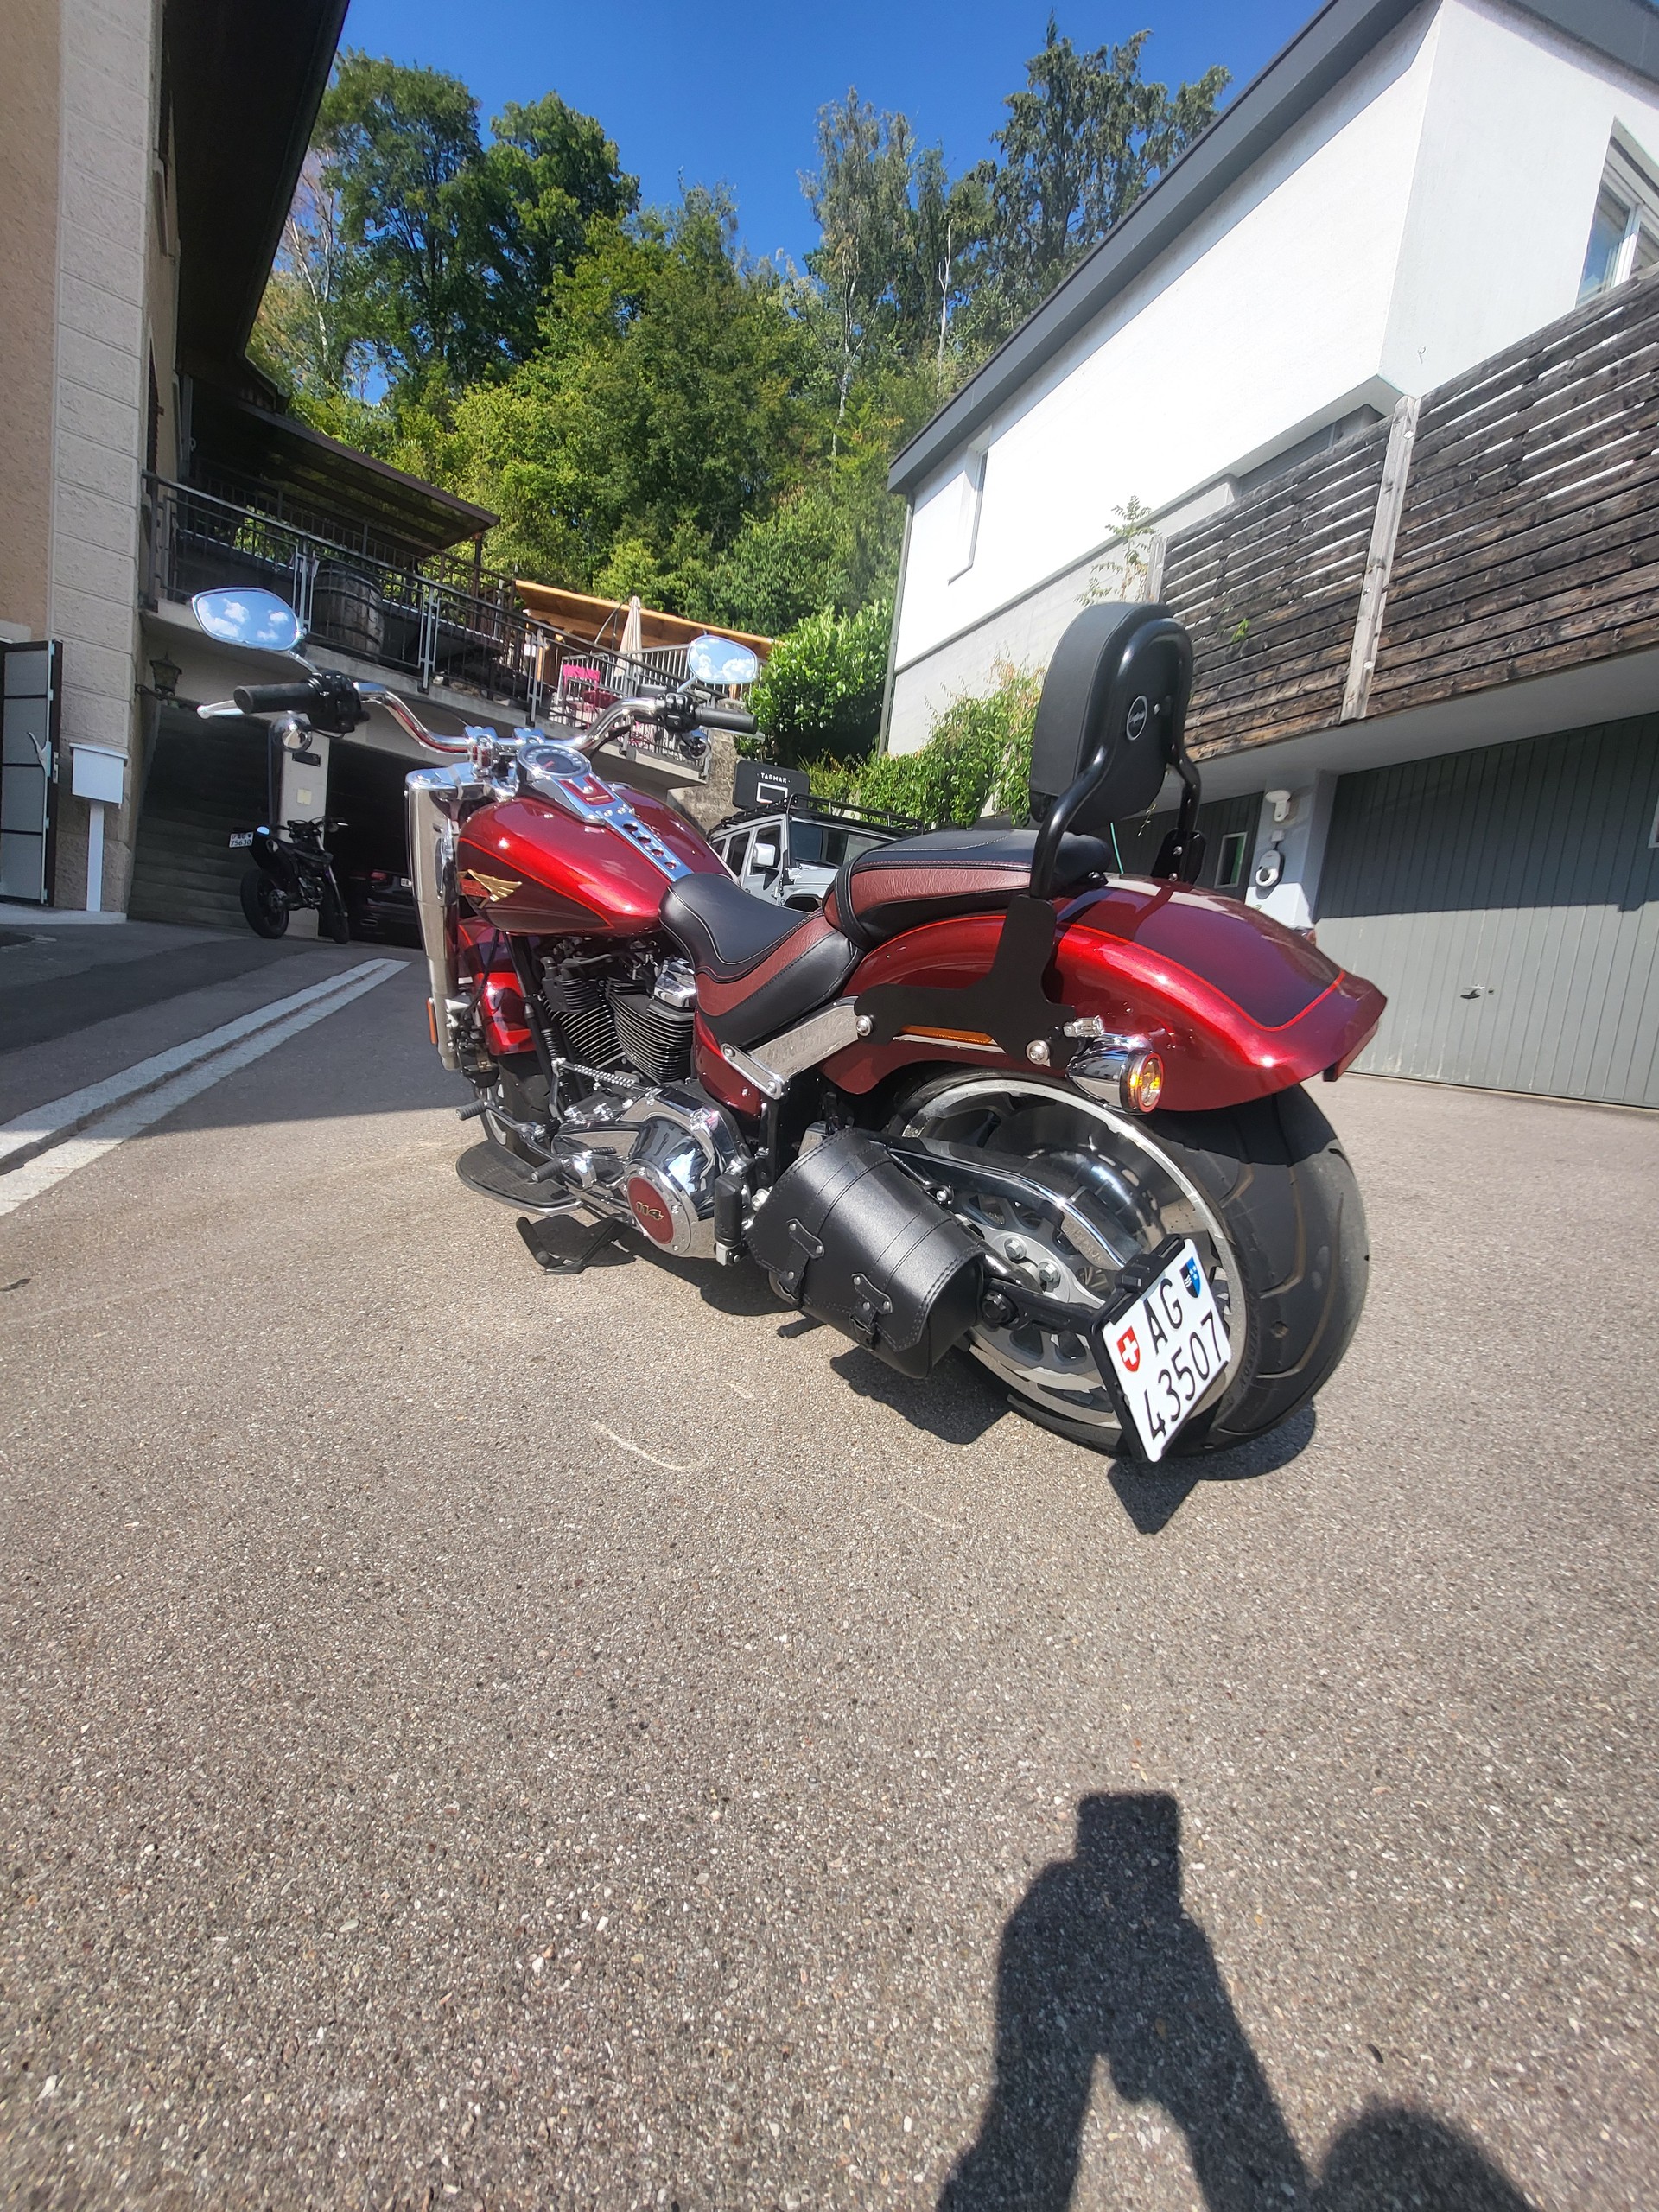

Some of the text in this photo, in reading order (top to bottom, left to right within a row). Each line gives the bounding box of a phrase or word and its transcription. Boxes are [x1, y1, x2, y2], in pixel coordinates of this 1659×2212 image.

[760, 772, 787, 784] TARMAK
[1143, 1279, 1183, 1355] AG
[1144, 1309, 1222, 1440] 43507
